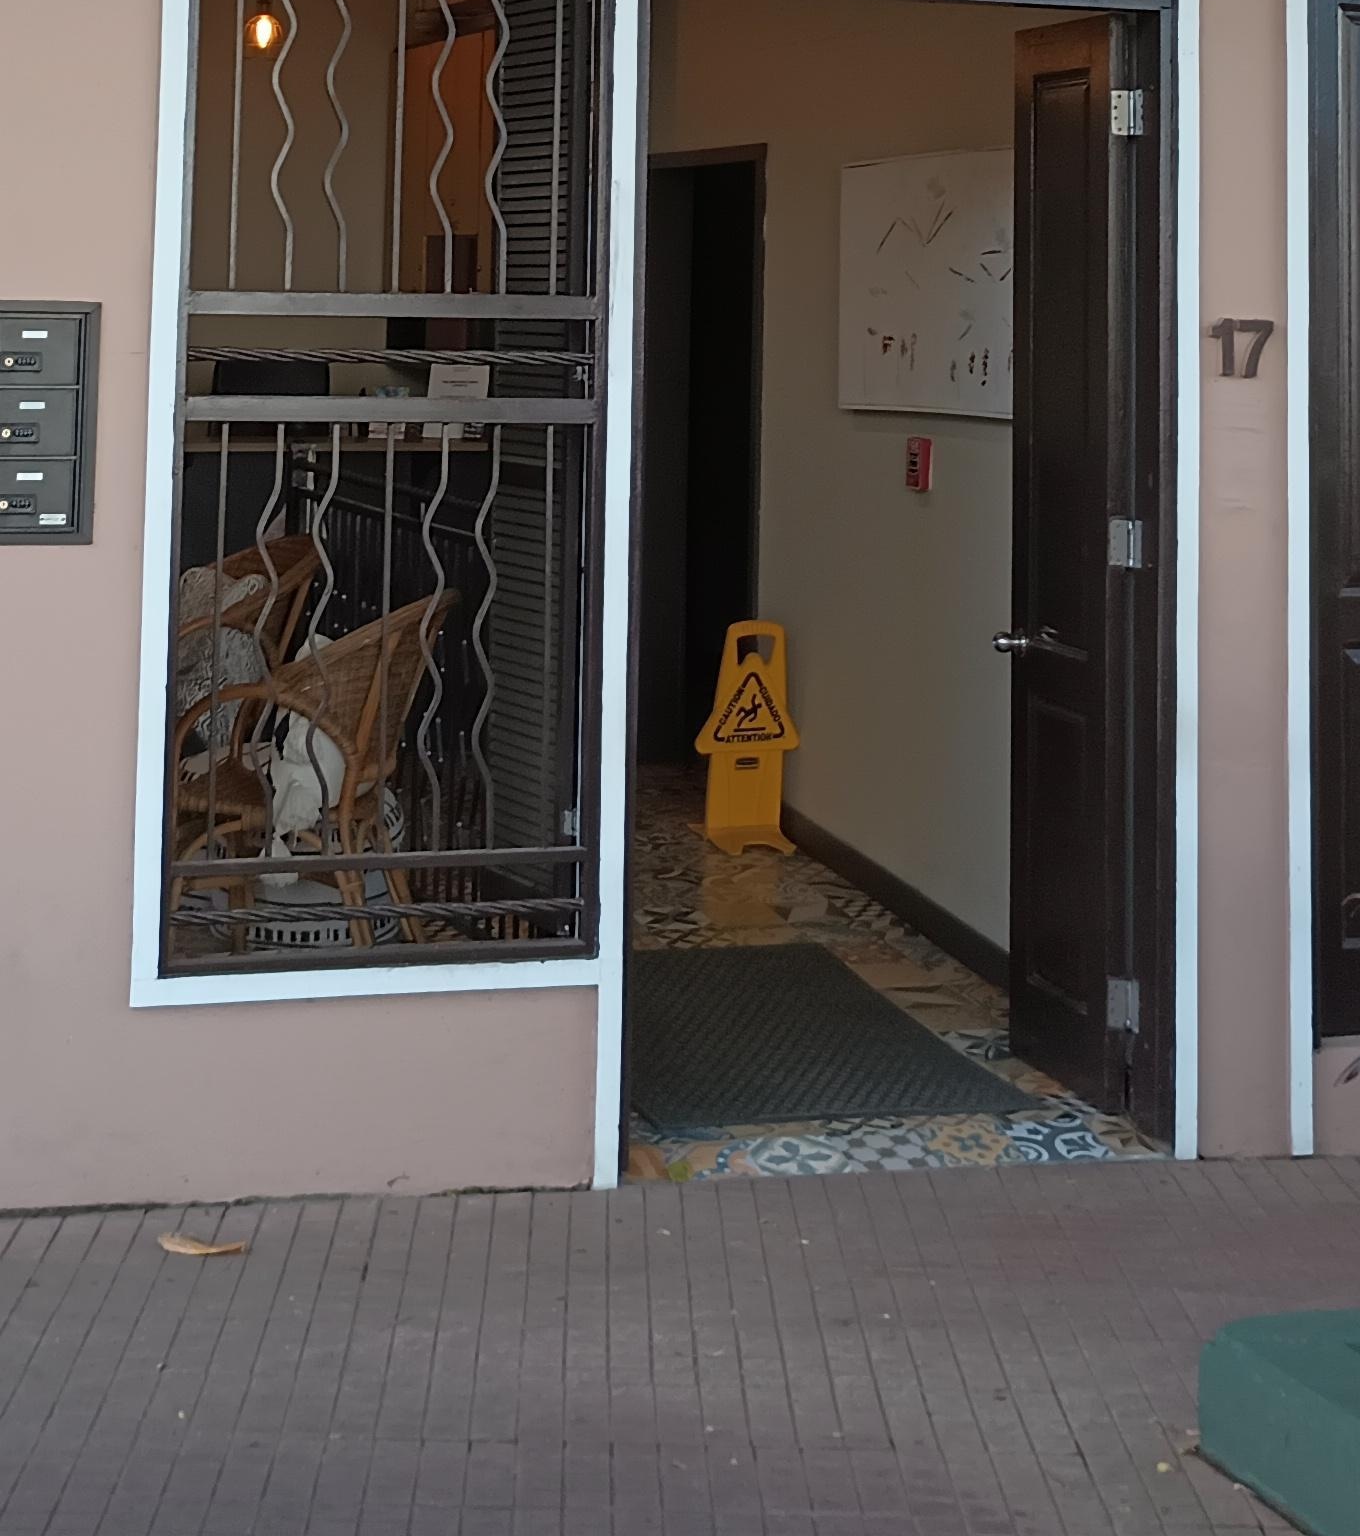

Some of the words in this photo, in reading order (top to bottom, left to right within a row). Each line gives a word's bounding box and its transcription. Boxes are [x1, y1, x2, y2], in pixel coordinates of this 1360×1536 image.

[1210, 318, 1274, 379] 17
[719, 686, 745, 725] CAUTION
[759, 685, 782, 723] CUIDADO
[725, 732, 774, 744] ATTENTION
